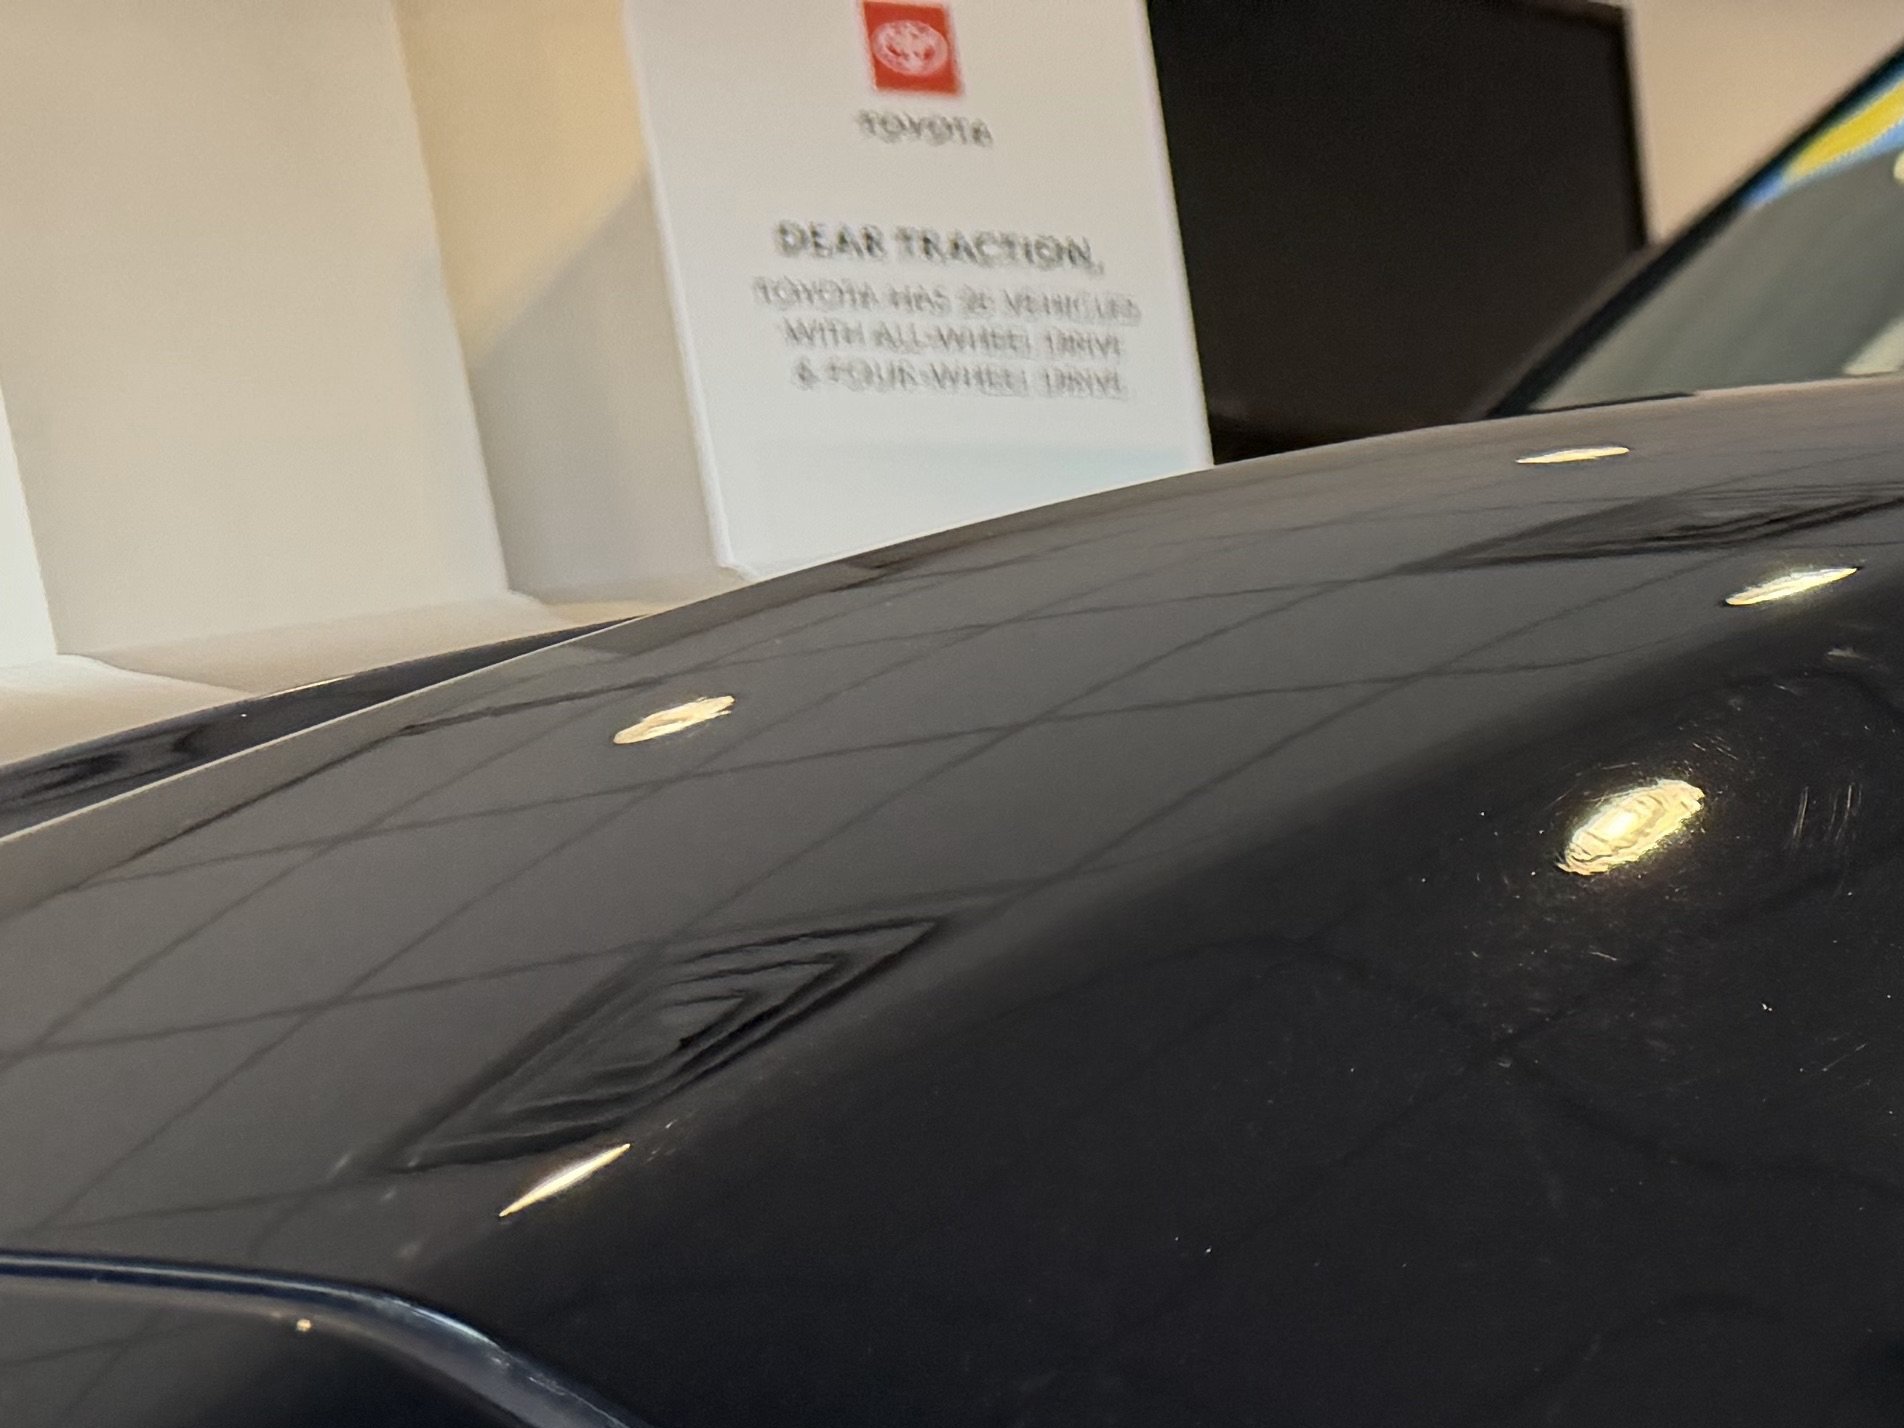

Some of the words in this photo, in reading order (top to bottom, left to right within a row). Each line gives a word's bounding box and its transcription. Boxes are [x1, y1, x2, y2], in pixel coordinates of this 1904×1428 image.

[856, 110, 993, 147] TOYOTA
[775, 219, 885, 261] DEAR
[895, 225, 1105, 276] TRACTION,
[752, 276, 878, 311] TOYOTA
[888, 283, 951, 315] HAS
[783, 317, 866, 350] WITH
